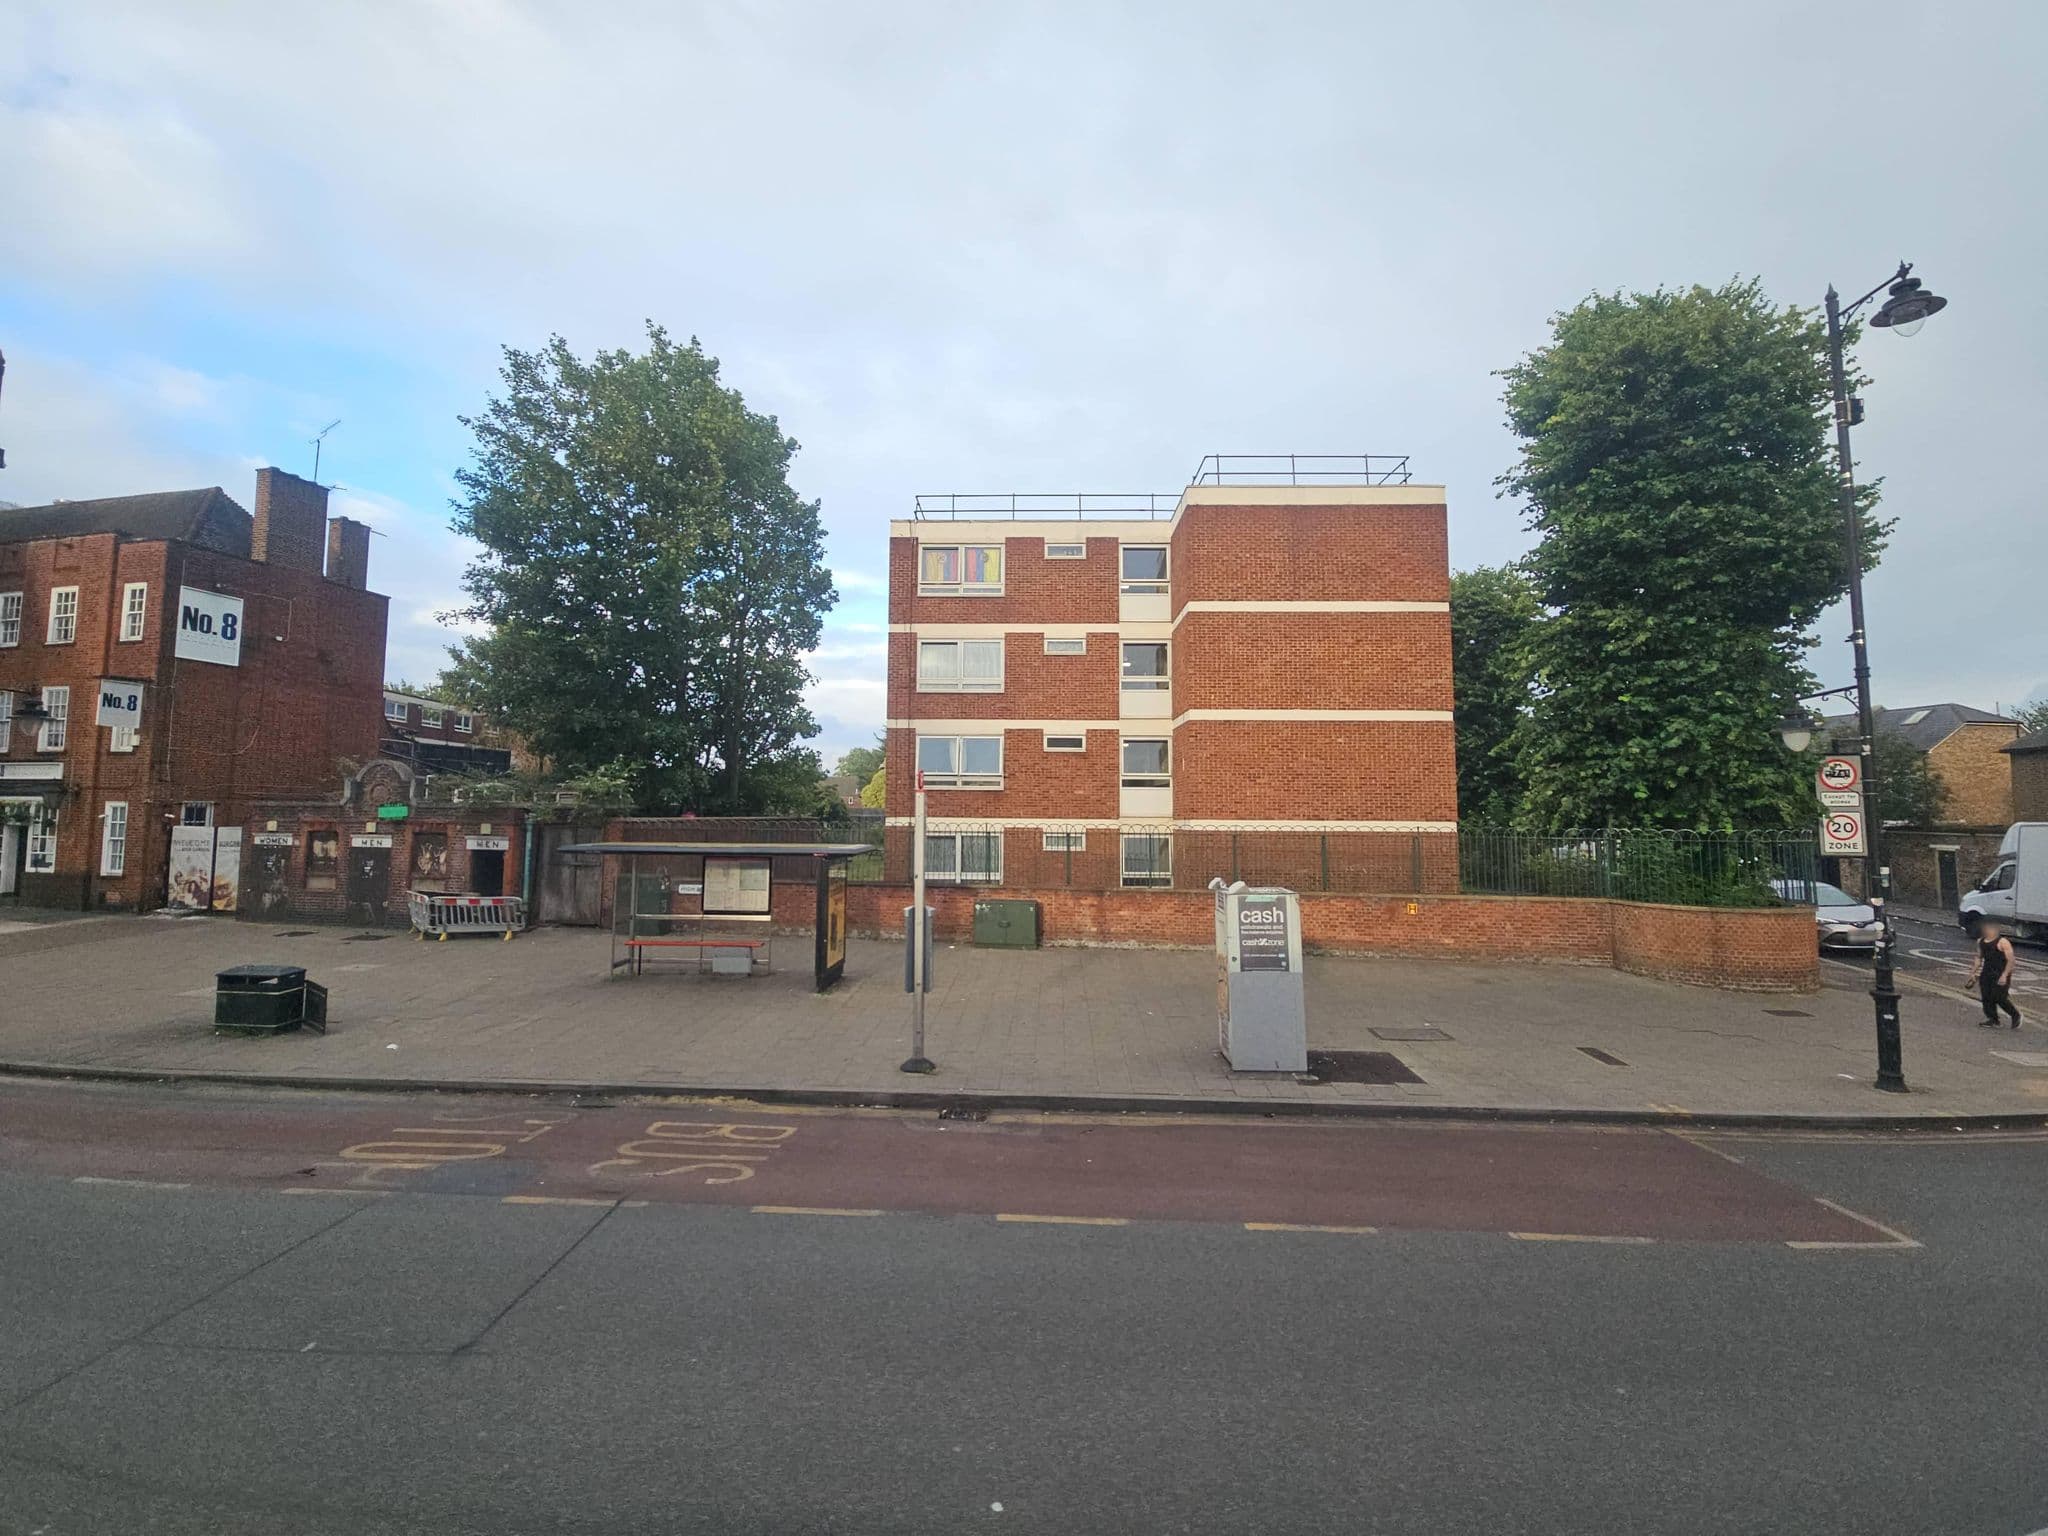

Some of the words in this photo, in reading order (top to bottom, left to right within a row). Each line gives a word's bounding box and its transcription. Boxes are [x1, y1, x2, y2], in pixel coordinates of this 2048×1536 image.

[182, 605, 217, 635] No.
[221, 613, 237, 640] 8
[102, 693, 125, 709] No.
[127, 695, 138, 711] 8
[1832, 822, 1854, 832] 20
[476, 840, 499, 848] MEN
[1829, 842, 1859, 850] ZONE
[1240, 906, 1284, 923] cash
[592, 1121, 797, 1185] BUS
